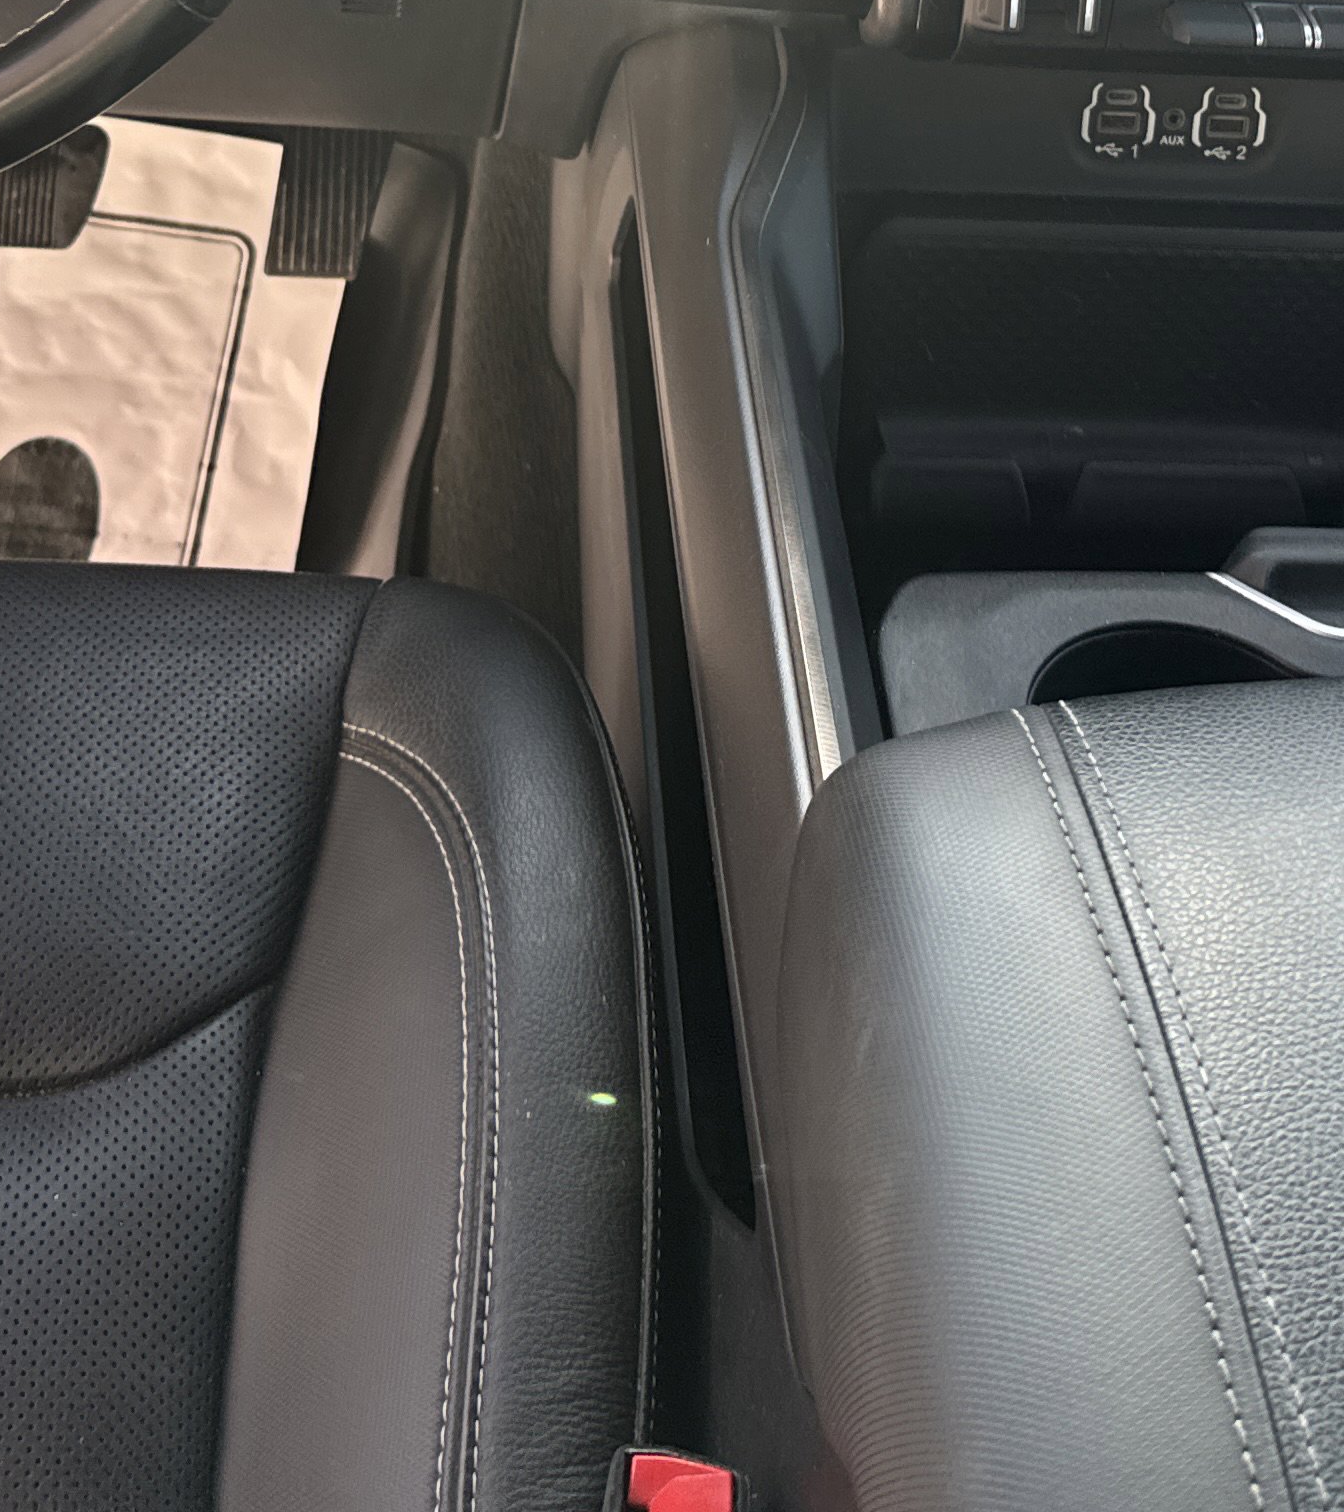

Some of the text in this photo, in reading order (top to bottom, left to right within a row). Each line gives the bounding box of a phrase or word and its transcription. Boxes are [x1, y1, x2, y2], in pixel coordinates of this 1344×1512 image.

[1159, 135, 1185, 147] AUX
[1130, 144, 1138, 159] 1
[1236, 145, 1247, 160] 2
